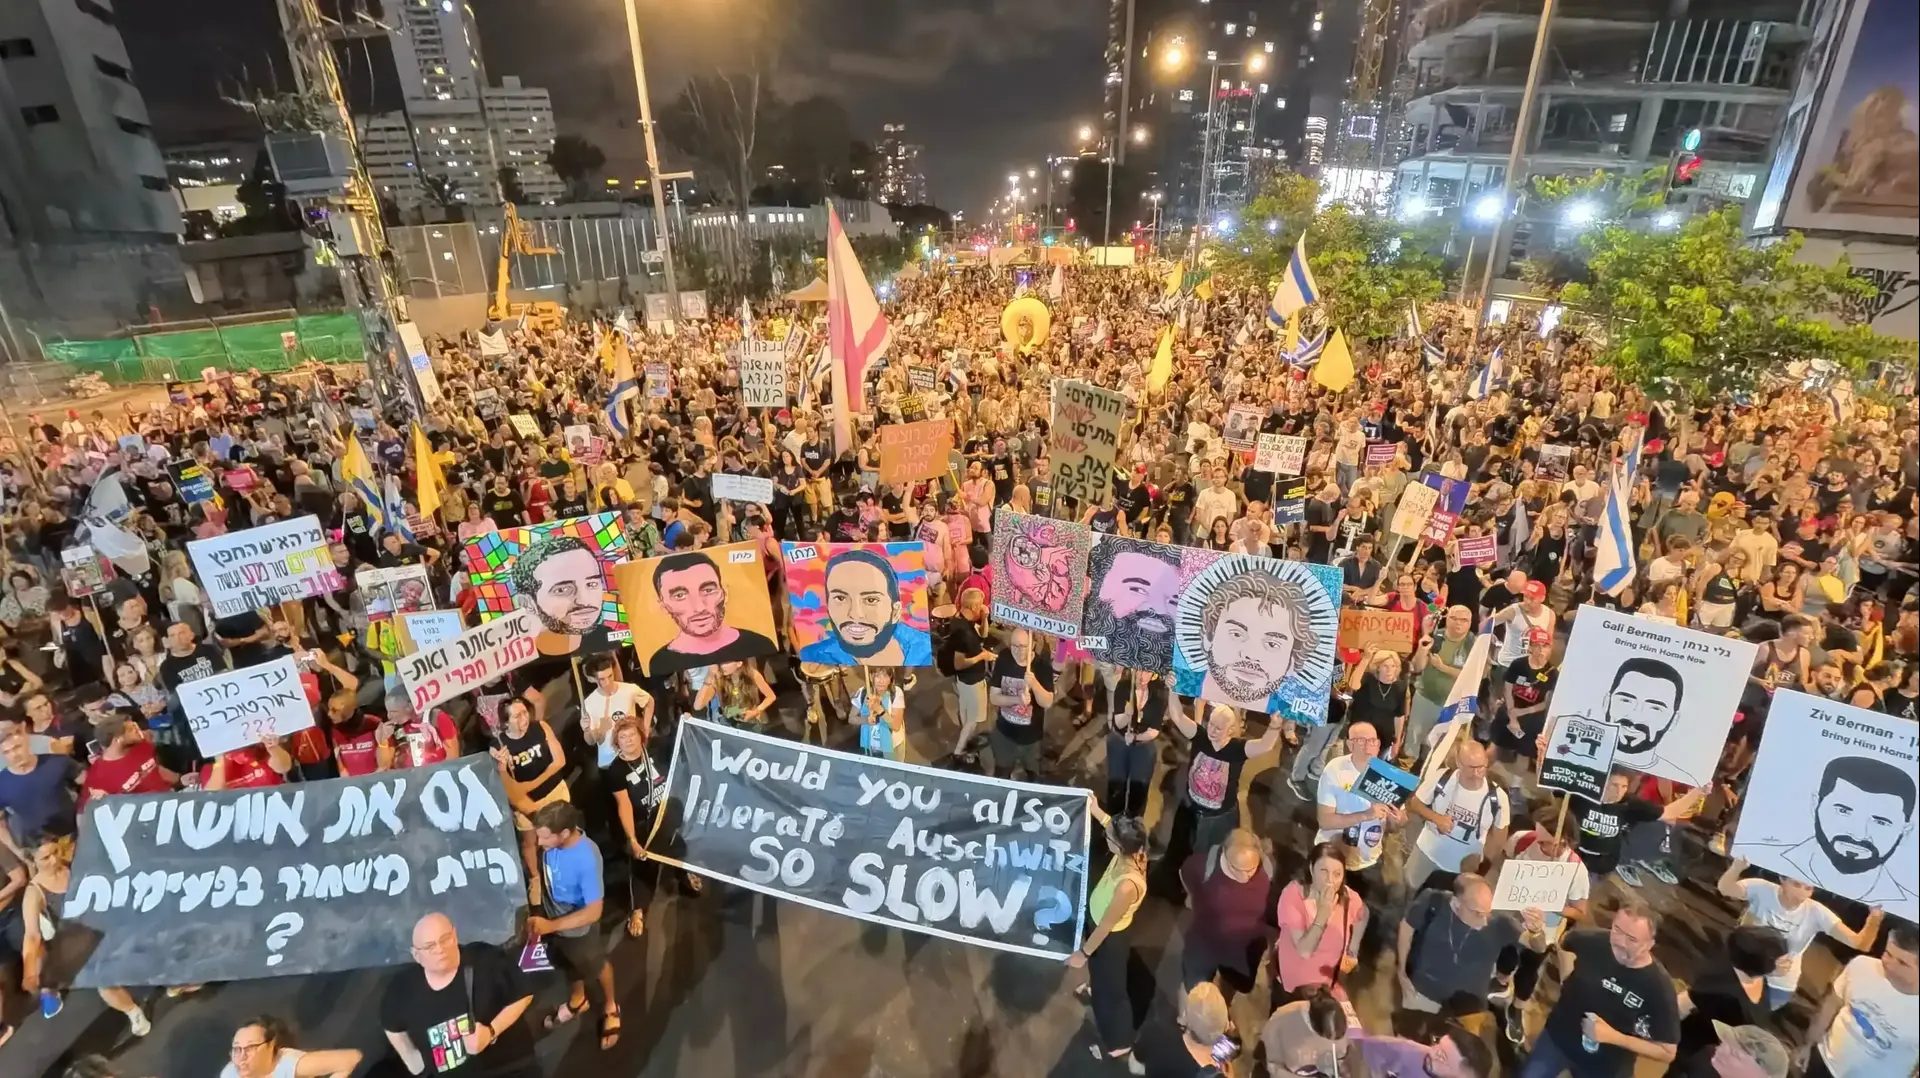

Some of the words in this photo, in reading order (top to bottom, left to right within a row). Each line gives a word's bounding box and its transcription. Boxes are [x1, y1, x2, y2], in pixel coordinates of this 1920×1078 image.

[743, 359, 783, 372] ממשלה
[745, 372, 783, 387] בוגדת
[744, 387, 783, 403] בעמה
[1060, 462, 1106, 490] כולם
[1081, 454, 1110, 479] את
[260, 533, 302, 556] האיש
[303, 528, 322, 543] מי
[1423, 526, 1447, 542] AR
[208, 543, 259, 568] החפץ
[789, 547, 816, 563] מתן
[267, 559, 289, 579] סור
[241, 584, 282, 610] שלום
[995, 605, 1029, 623] אחת!
[1034, 616, 1076, 636] פעימה
[1343, 616, 1382, 632] DEAD
[1602, 620, 1625, 633] Gali
[1626, 626, 1672, 644] Berman
[1713, 646, 1732, 658] גלי
[1615, 637, 1637, 650] Bring
[1639, 643, 1657, 654] Him
[1659, 649, 1685, 660] Home
[1686, 654, 1706, 665] Now
[493, 636, 535, 671] כולנו
[248, 667, 288, 689] עד
[444, 658, 488, 687] חברי
[196, 681, 241, 707] מתי
[209, 689, 302, 724] אוקטובר
[414, 678, 441, 712] כת
[1292, 699, 1319, 715] אלון
[1809, 708, 1832, 722] Ziv
[1835, 715, 1895, 740] Berman
[1565, 733, 1602, 757] די
[1821, 728, 1851, 745] Bring
[1852, 737, 1877, 751] Him
[1879, 745, 1914, 761] Home
[1376, 776, 1399, 793] לא
[1552, 765, 1577, 779] הסכם
[1579, 771, 1596, 783] בלי
[710, 739, 831, 792] Would
[857, 772, 941, 813] you
[972, 789, 1071, 835] also
[323, 778, 408, 846] את
[430, 847, 518, 895] היית
[740, 836, 815, 888] SO
[62, 863, 263, 920] בפעימות
[265, 911, 304, 966] ?
